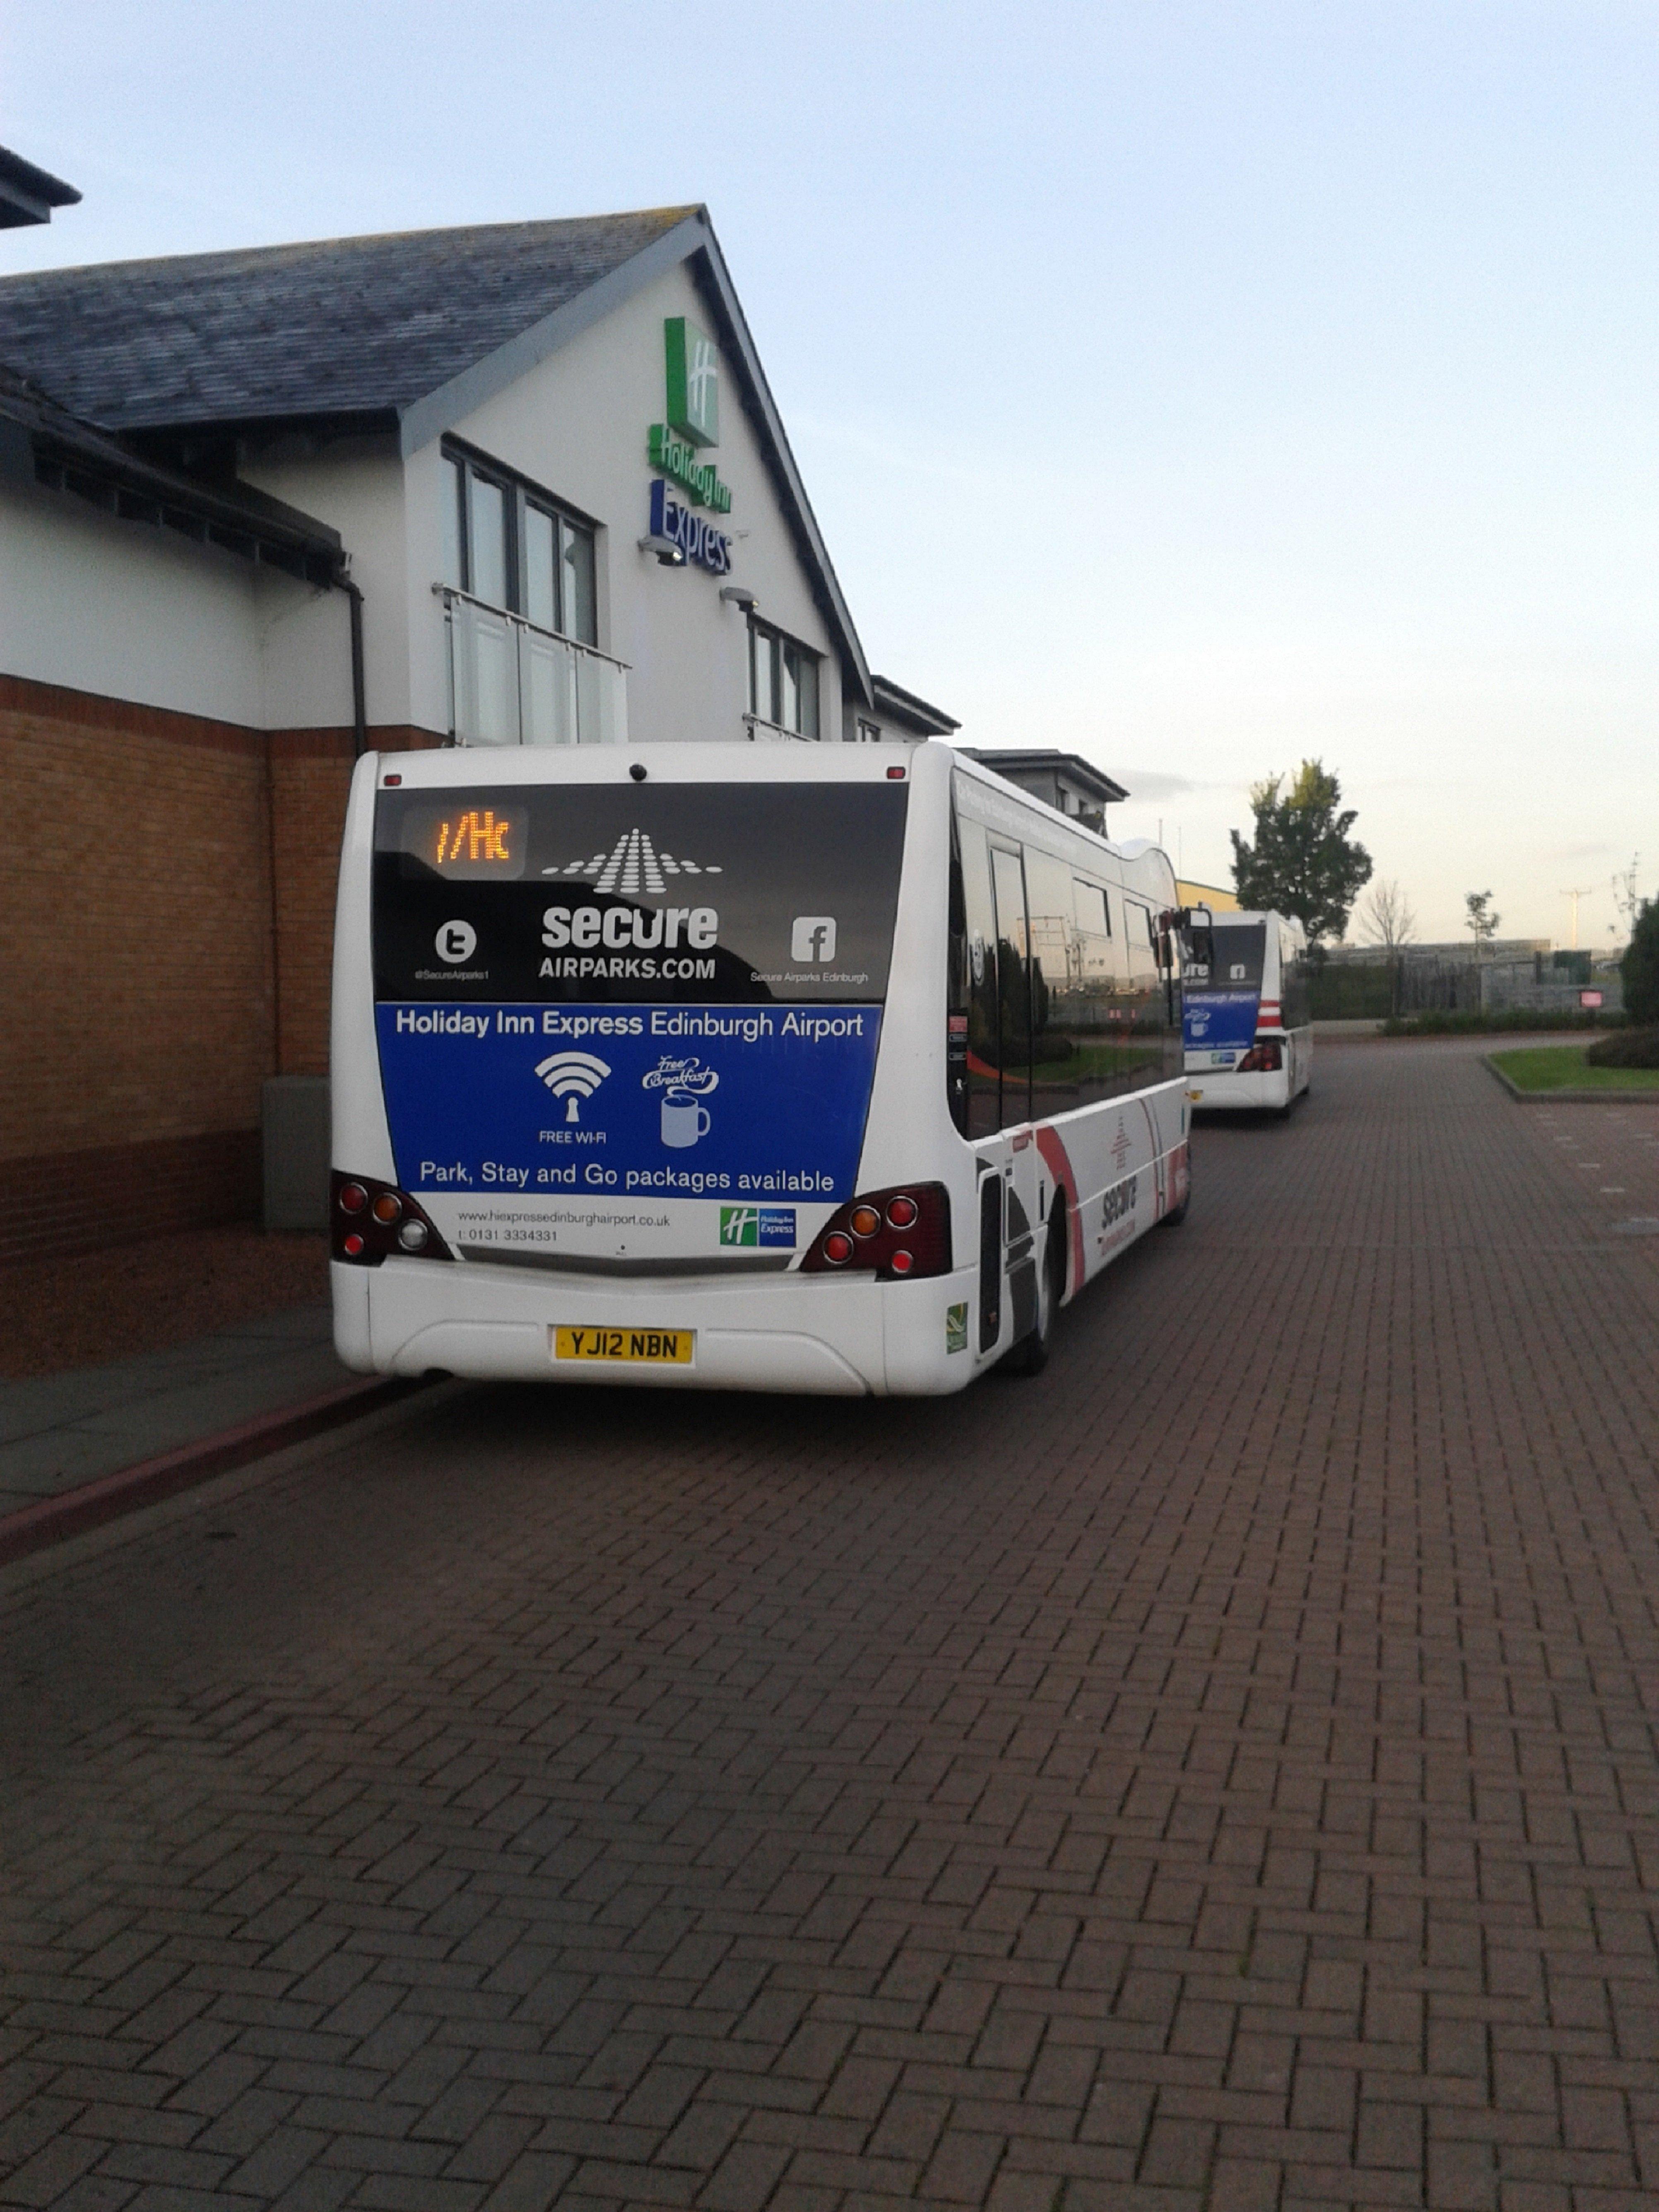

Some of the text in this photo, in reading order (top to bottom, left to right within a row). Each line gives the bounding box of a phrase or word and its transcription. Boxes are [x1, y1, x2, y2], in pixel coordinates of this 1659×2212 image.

[654, 423, 732, 513] Holiday Inn
[657, 480, 733, 576] Express
[541, 906, 719, 949] secure
[539, 958, 716, 979] AIRPARKS.COM
[750, 972, 869, 984] Secure Airparks Edinburgh
[396, 1009, 864, 1043] Holiday Inn Express Edinburgh Airport
[657, 1055, 693, 1071] Free
[644, 1066, 716, 1089] Breakfast
[539, 1131, 573, 1143] FREE
[420, 1161, 834, 1192] Park, Stay and Go packages available
[458, 1210, 670, 1227] www.hiexpressedinburghairport.co.uk
[761, 1223, 794, 1234] Express
[469, 1230, 498, 1240] 0131
[504, 1230, 558, 1241] 3334331
[571, 1331, 678, 1358] YJ12 NBN
